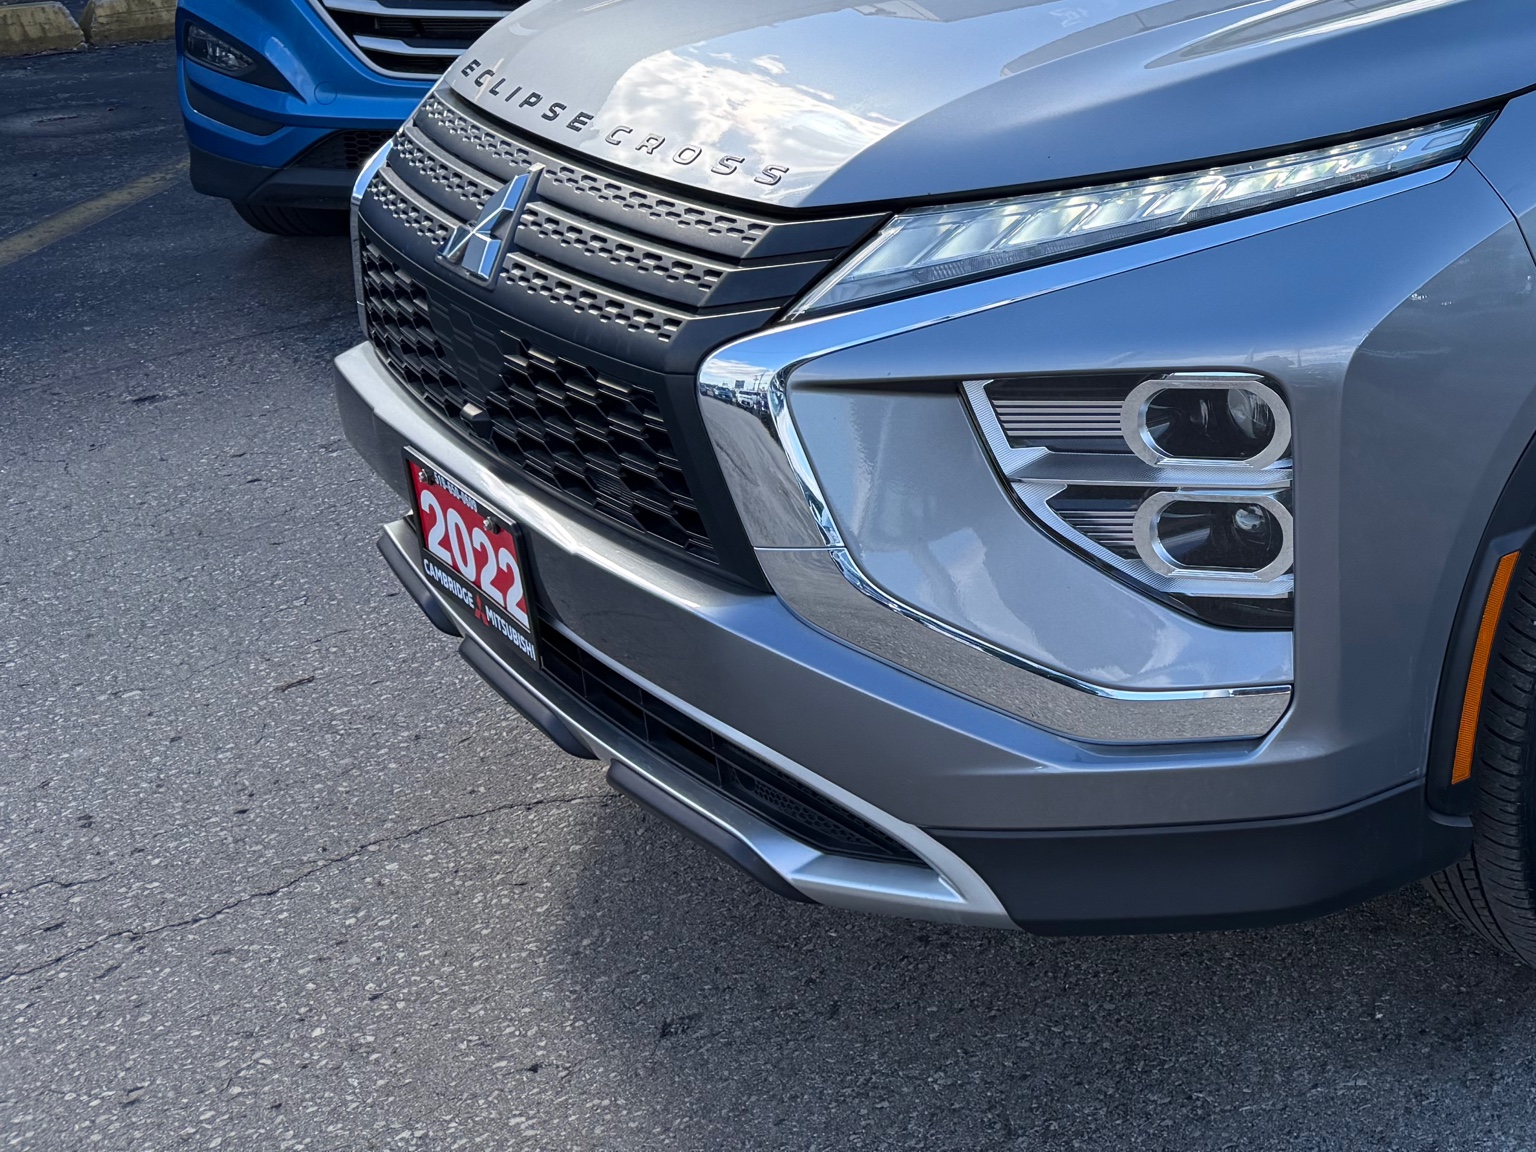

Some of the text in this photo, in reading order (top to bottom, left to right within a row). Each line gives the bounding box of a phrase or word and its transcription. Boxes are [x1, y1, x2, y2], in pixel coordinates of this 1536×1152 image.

[461, 59, 790, 186] ECLIPSE CROSS
[420, 489, 530, 630] 2022
[423, 558, 537, 662] CAMBRIDGE MITSUBISHI
